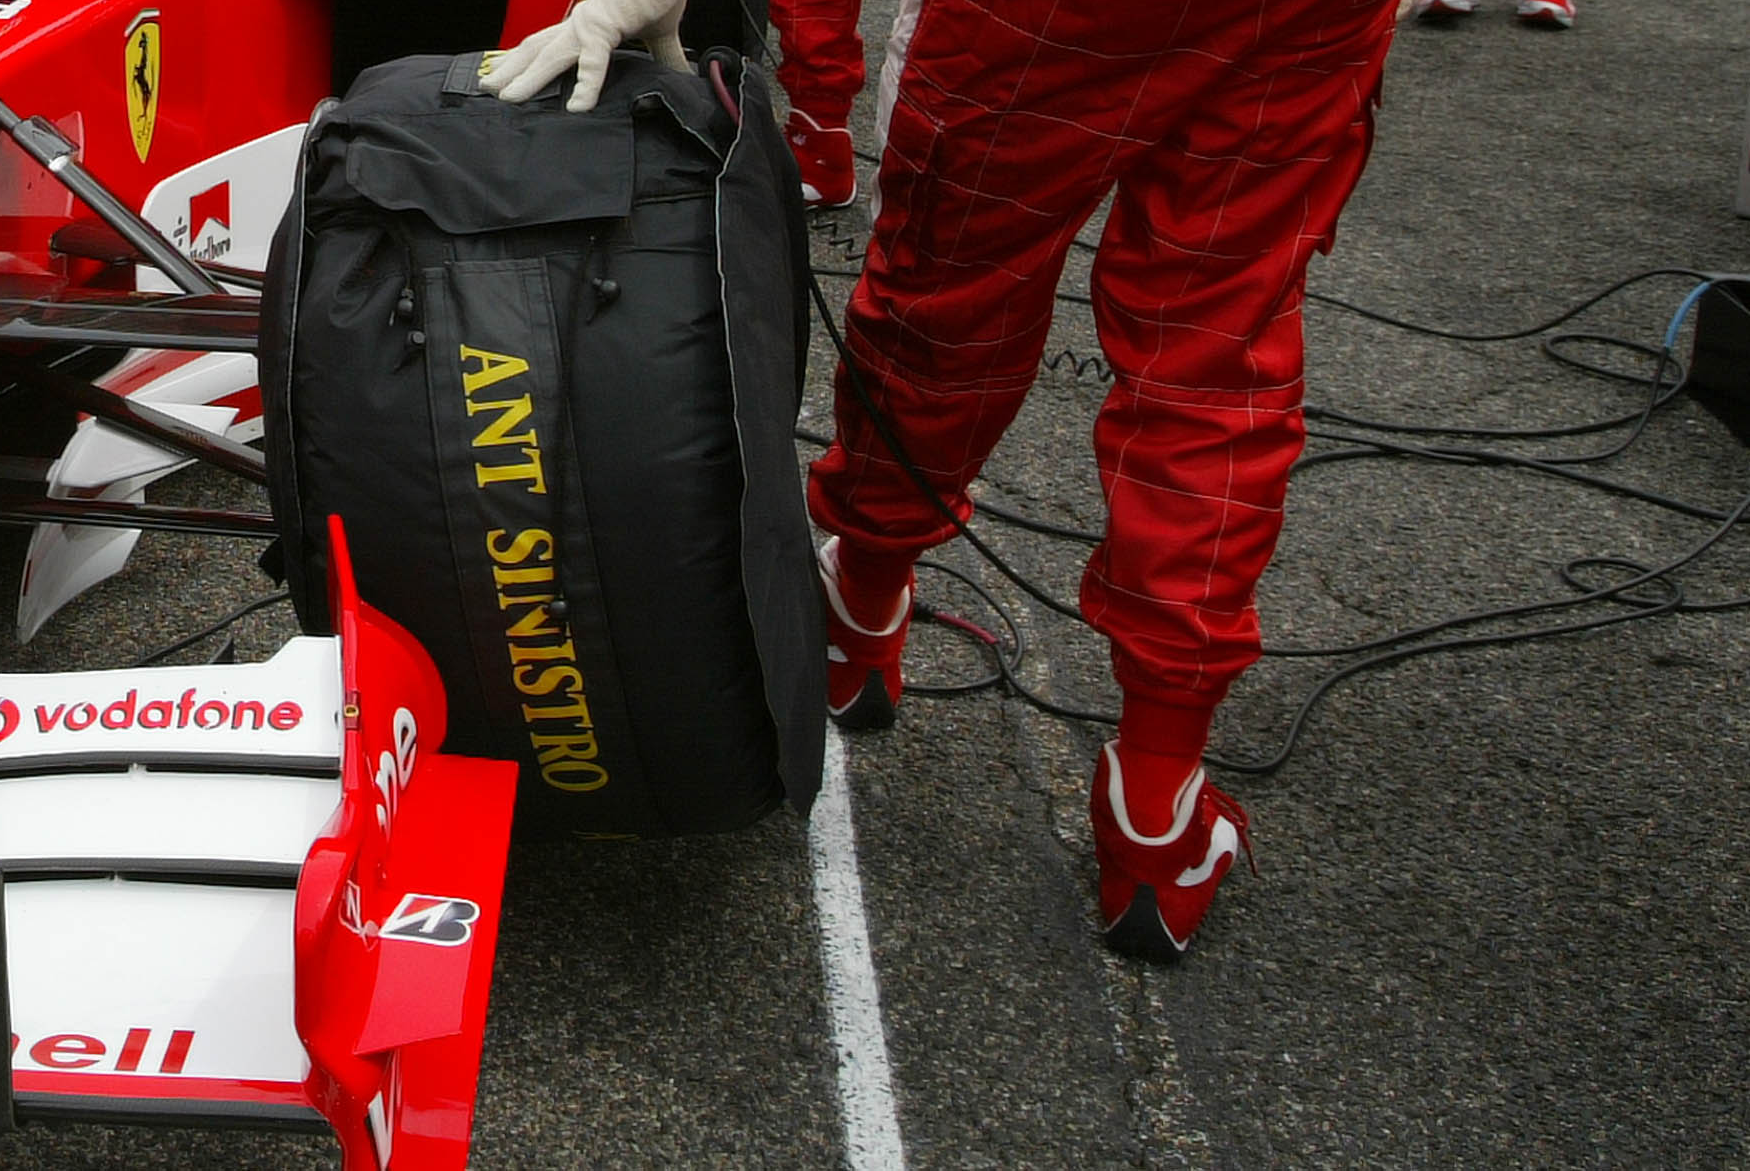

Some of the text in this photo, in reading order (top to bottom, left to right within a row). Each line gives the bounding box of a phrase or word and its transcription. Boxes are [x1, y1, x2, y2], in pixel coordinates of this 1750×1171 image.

[459, 343, 610, 793] ANT SINISTRO
[34, 687, 304, 734] vodafone
[12, 1027, 196, 1074] ell
